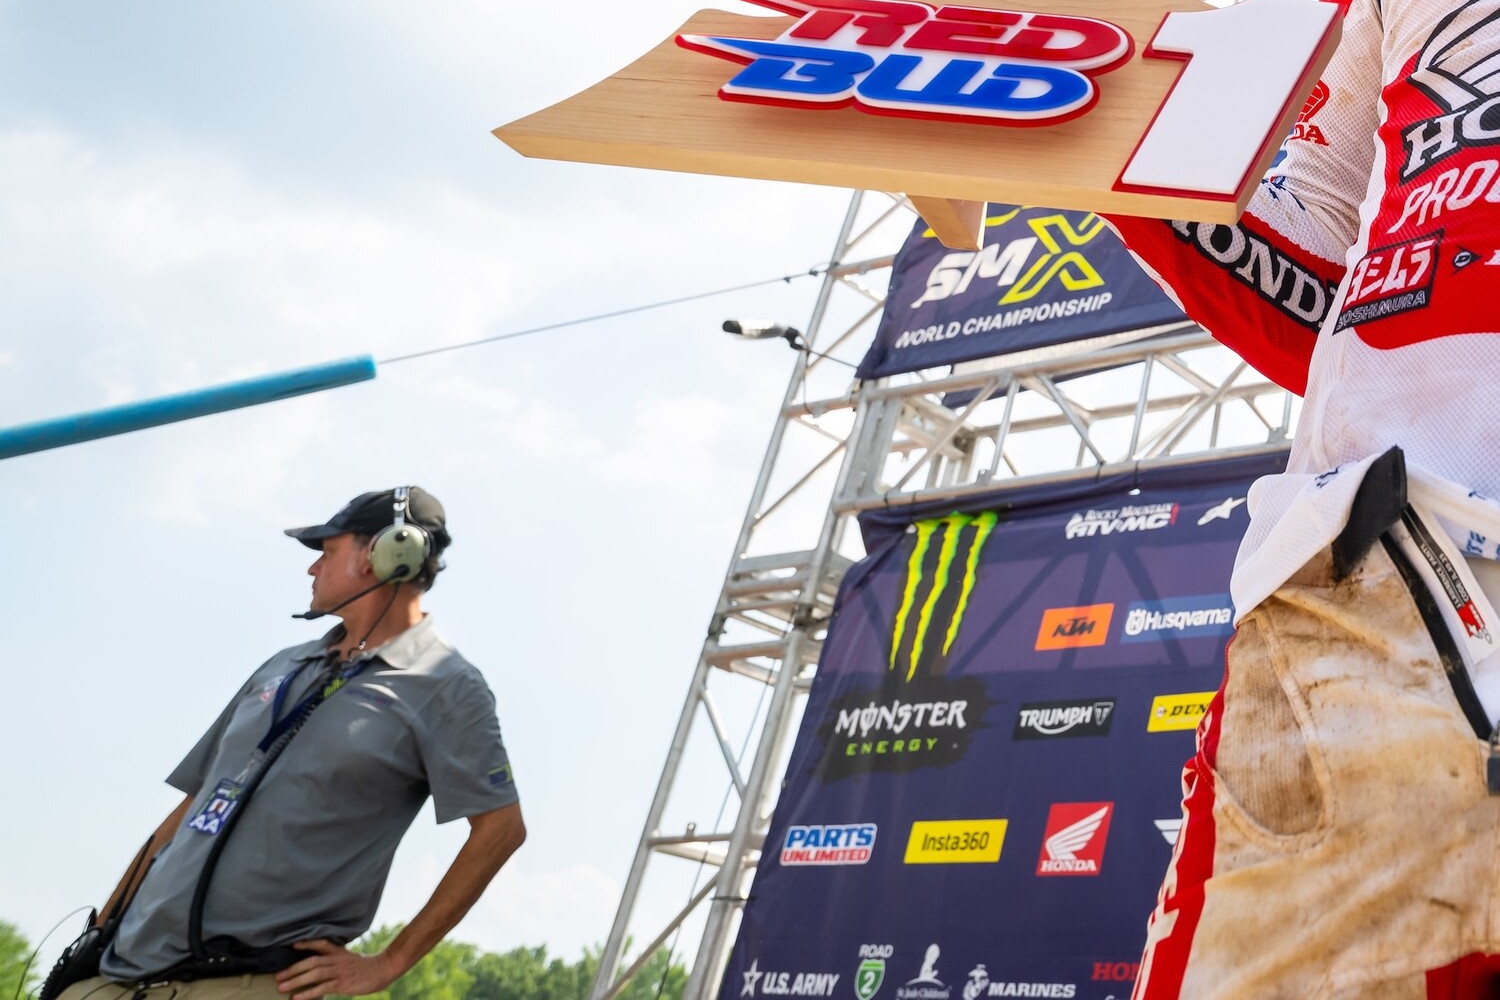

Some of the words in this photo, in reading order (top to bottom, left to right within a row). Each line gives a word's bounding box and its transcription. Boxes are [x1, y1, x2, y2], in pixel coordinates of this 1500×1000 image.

[677, 34, 1096, 122] BUD
[911, 204, 1105, 309] SMX
[1172, 219, 1340, 328] OND
[895, 321, 961, 349] WORLD
[962, 292, 1113, 333] CHAMPIONSHIP
[1084, 509, 1119, 521] ROCKY
[1119, 502, 1173, 518] MOUNTAIN
[1052, 616, 1097, 638] KTM
[1144, 608, 1232, 631] Husqvarna
[834, 700, 968, 738] MONSTER
[1019, 704, 1093, 735] TRIUMPH
[1170, 703, 1209, 716] DUN
[846, 738, 938, 756] ENERGY
[786, 825, 876, 848] PARTS
[920, 832, 990, 851] Insta360
[782, 846, 870, 864] UNLIMITED
[1040, 859, 1097, 873] HONDA
[858, 944, 894, 959] ROAD
[1091, 962, 1141, 981] HON
[790, 973, 840, 996] ARMY
[861, 970, 876, 996] 2
[988, 981, 1077, 998] MARINES
